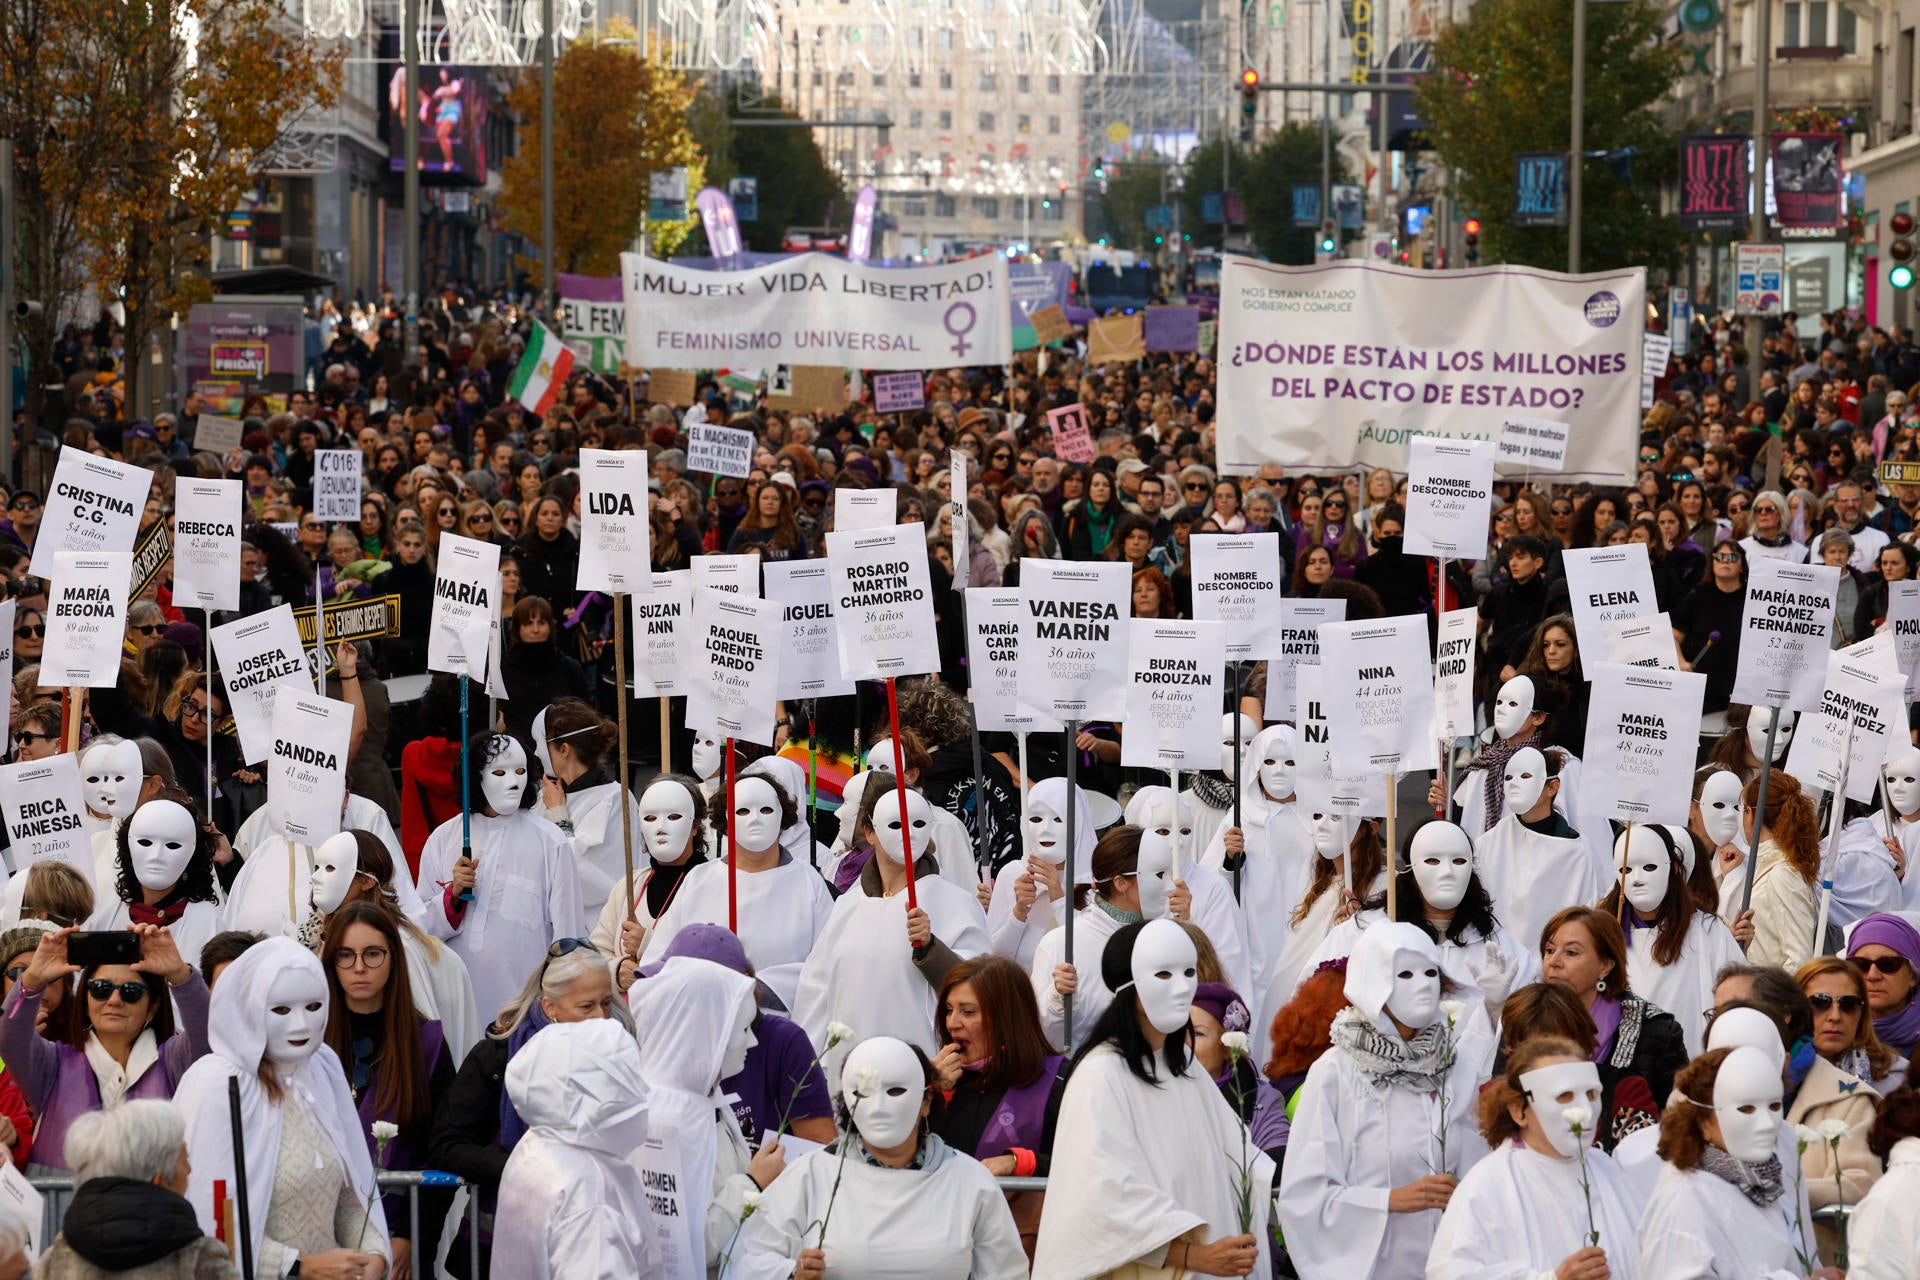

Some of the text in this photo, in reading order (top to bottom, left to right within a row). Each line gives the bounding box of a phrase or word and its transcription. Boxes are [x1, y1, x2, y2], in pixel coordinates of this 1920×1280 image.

[634, 271, 994, 301] ¡MUJER VIDA LIBERTAD!
[564, 304, 584, 332] EL
[657, 330, 920, 352] FEMINISMO UNIVERSAL
[1232, 339, 1335, 366] ¿DÓNDE
[1343, 340, 1428, 370] ESTÁN
[1438, 351, 1484, 371] LOS
[1492, 352, 1627, 375] MILLONES
[1271, 377, 1584, 409] DEL PACTO DE ESTADO?
[691, 427, 701, 440] EL
[1358, 425, 1451, 444] ¡AUDIT
[710, 445, 748, 461] CRIMEN
[721, 460, 747, 474] TODOS
[1884, 464, 1902, 480] LAS
[1428, 477, 1471, 489] NOMBRE
[57, 482, 134, 517] CRISTINA
[1412, 484, 1486, 499] DESCONOCIDO
[589, 492, 635, 516] LIDA
[1429, 499, 1466, 511] 42 años
[73, 505, 108, 526] C.G.
[65, 520, 107, 542] 54 años
[178, 521, 235, 537] REBECCA
[190, 538, 219, 550] 42 años
[854, 538, 882, 546] ASESINADA
[846, 561, 910, 580] ROSARIO
[1214, 572, 1258, 581] NOMBRE
[852, 574, 908, 593] MARTÍN
[1198, 581, 1274, 591] DESCONOCIDO
[64, 585, 110, 601] MARÍA
[436, 577, 488, 608] MARÍA
[840, 588, 924, 609] CHAMORRO
[1218, 595, 1256, 605] 46 años
[1589, 590, 1640, 608] ELENA
[1750, 589, 1831, 610] MARÍA ROSA
[56, 601, 115, 618] BEGOÑA
[451, 605, 472, 618] años
[639, 603, 681, 619] SUZAN
[864, 610, 904, 624] 36 años
[1029, 600, 1119, 620] VANESA
[1600, 610, 1636, 622] 68 años
[1767, 603, 1814, 621] GÓMEZ
[65, 622, 100, 633] 89 años
[295, 612, 336, 641] MUJES
[647, 620, 674, 635] ANN
[793, 625, 827, 637] 35 años
[978, 621, 1019, 635] MARÍA
[1036, 620, 1110, 642] MARÍN
[1351, 629, 1382, 637] ASESINADA
[1749, 617, 1826, 636] FERNÁNDEZ
[710, 625, 760, 646] RAQUEL
[1282, 629, 1319, 641] FRAN
[656, 640, 675, 649] años
[705, 638, 763, 660] LORENTE
[1439, 638, 1472, 658] KIRSTY
[1768, 637, 1804, 651] 52 años
[989, 651, 1018, 661] GAR
[1048, 646, 1096, 660] 36 años
[236, 648, 287, 675] JOSEFA
[711, 653, 755, 672] PARDO
[1149, 658, 1197, 672] BURAN
[1439, 659, 1466, 678] WARD
[229, 658, 302, 692] GONZÁLEZ
[712, 670, 750, 688] 58 años
[995, 668, 1008, 678] 60
[1050, 671, 1092, 680] (MADRID)
[1134, 672, 1212, 686] FOROUZAN
[1358, 666, 1395, 680] NINA
[1841, 664, 1867, 678] ASESINADA
[1626, 676, 1658, 685] ASESINADA
[252, 690, 264, 702] 79
[1151, 689, 1194, 702] 64 años
[1355, 685, 1402, 698] 44 años
[1185, 705, 1196, 713] LA
[1355, 699, 1402, 711] ROQUETAS
[1824, 689, 1879, 718] CARMEN
[1361, 707, 1400, 718] DEL MAR
[1621, 713, 1665, 728] MARÍA
[1820, 702, 1886, 735] ERNÁNDEZ
[1617, 724, 1668, 740] TORRES
[1825, 721, 1835, 733] 43
[274, 738, 338, 771] SANDRA
[1616, 740, 1664, 757] 48 años
[284, 765, 319, 784] 41 años
[287, 780, 313, 794] TOLEDO
[19, 798, 66, 820] ERICA
[11, 813, 82, 840] VANESSA
[31, 839, 70, 855] 22 años
[642, 1169, 677, 1193] CARMEN
